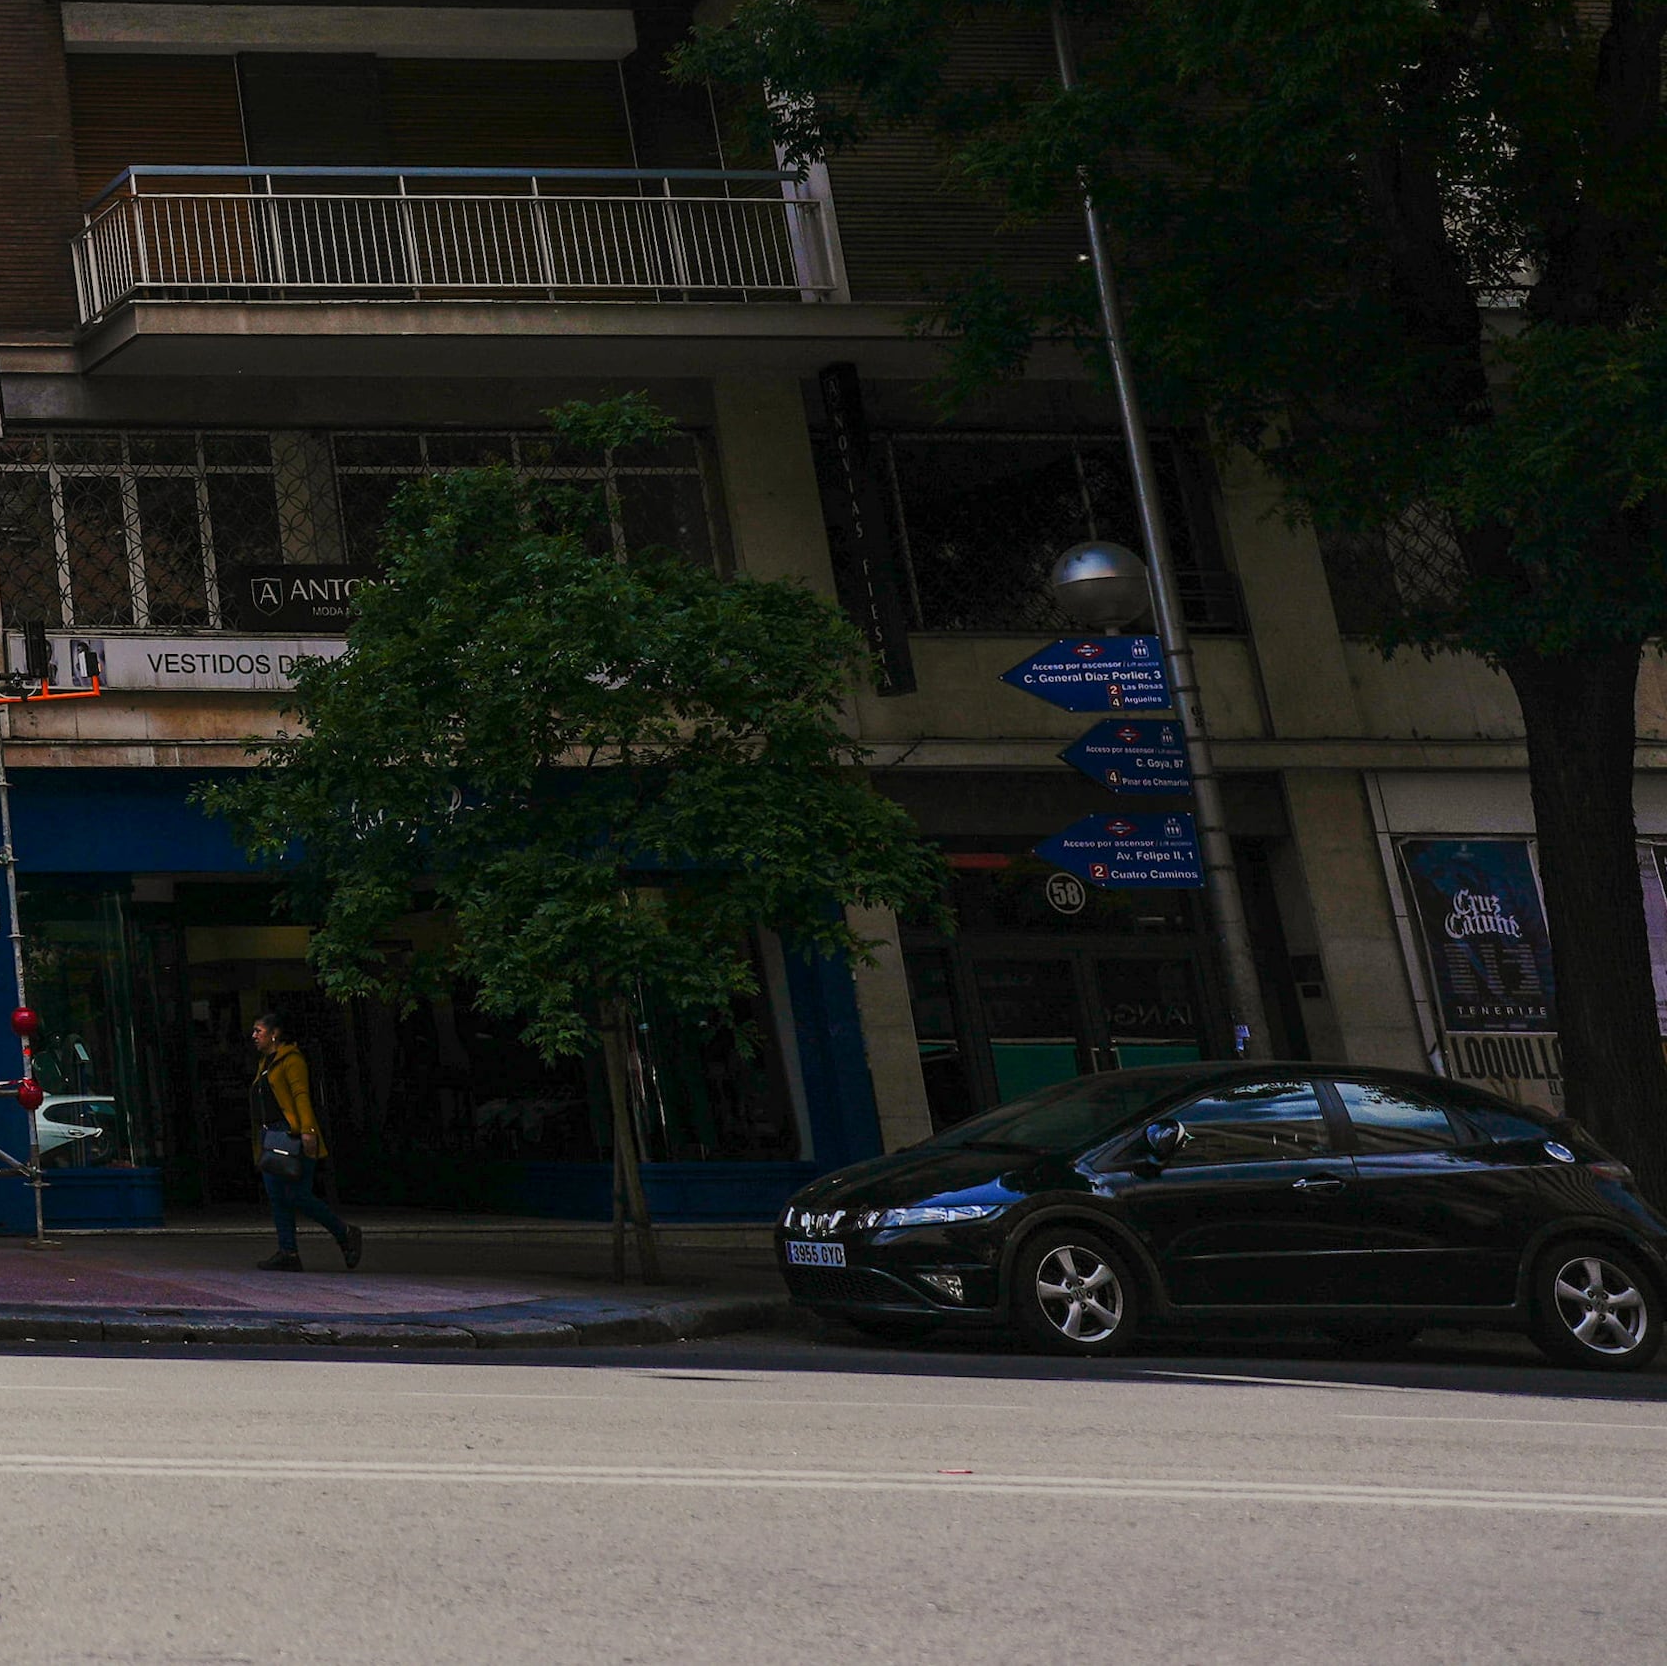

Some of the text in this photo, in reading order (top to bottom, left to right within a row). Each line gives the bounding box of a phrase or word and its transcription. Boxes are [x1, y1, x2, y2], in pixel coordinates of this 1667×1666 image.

[312, 606, 344, 616] MODA
[147, 654, 271, 674] VESTIDOS
[1032, 663, 1064, 671] Acceso
[1065, 662, 1081, 672] por
[1082, 661, 1122, 669] ascensor
[1023, 670, 1162, 684] C. General Díaz Porlier, 3
[1110, 682, 1164, 695] 2 Las Rosas
[1112, 697, 1121, 707] 4
[1085, 745, 1110, 753] Acceso
[1124, 746, 1155, 754] ascensor
[1135, 759, 1145, 768] C.
[1147, 759, 1173, 769] Goya,
[1110, 771, 1118, 783] 4
[1122, 778, 1142, 787] Pinar
[1142, 778, 1153, 787] de
[1063, 840, 1096, 848] Acceso
[1097, 840, 1113, 849] por
[1114, 839, 1154, 847] ascensor
[1116, 851, 1134, 861] Av.
[1136, 851, 1171, 862] Felipe
[1187, 851, 1194, 861] 1
[1094, 865, 1198, 879] 2 Cuatro Caminos
[1052, 882, 1081, 905] 58
[1452, 888, 1502, 915] Cruz
[1457, 1006, 1548, 1016] TENERIFE
[793, 1244, 819, 1263] 3955
